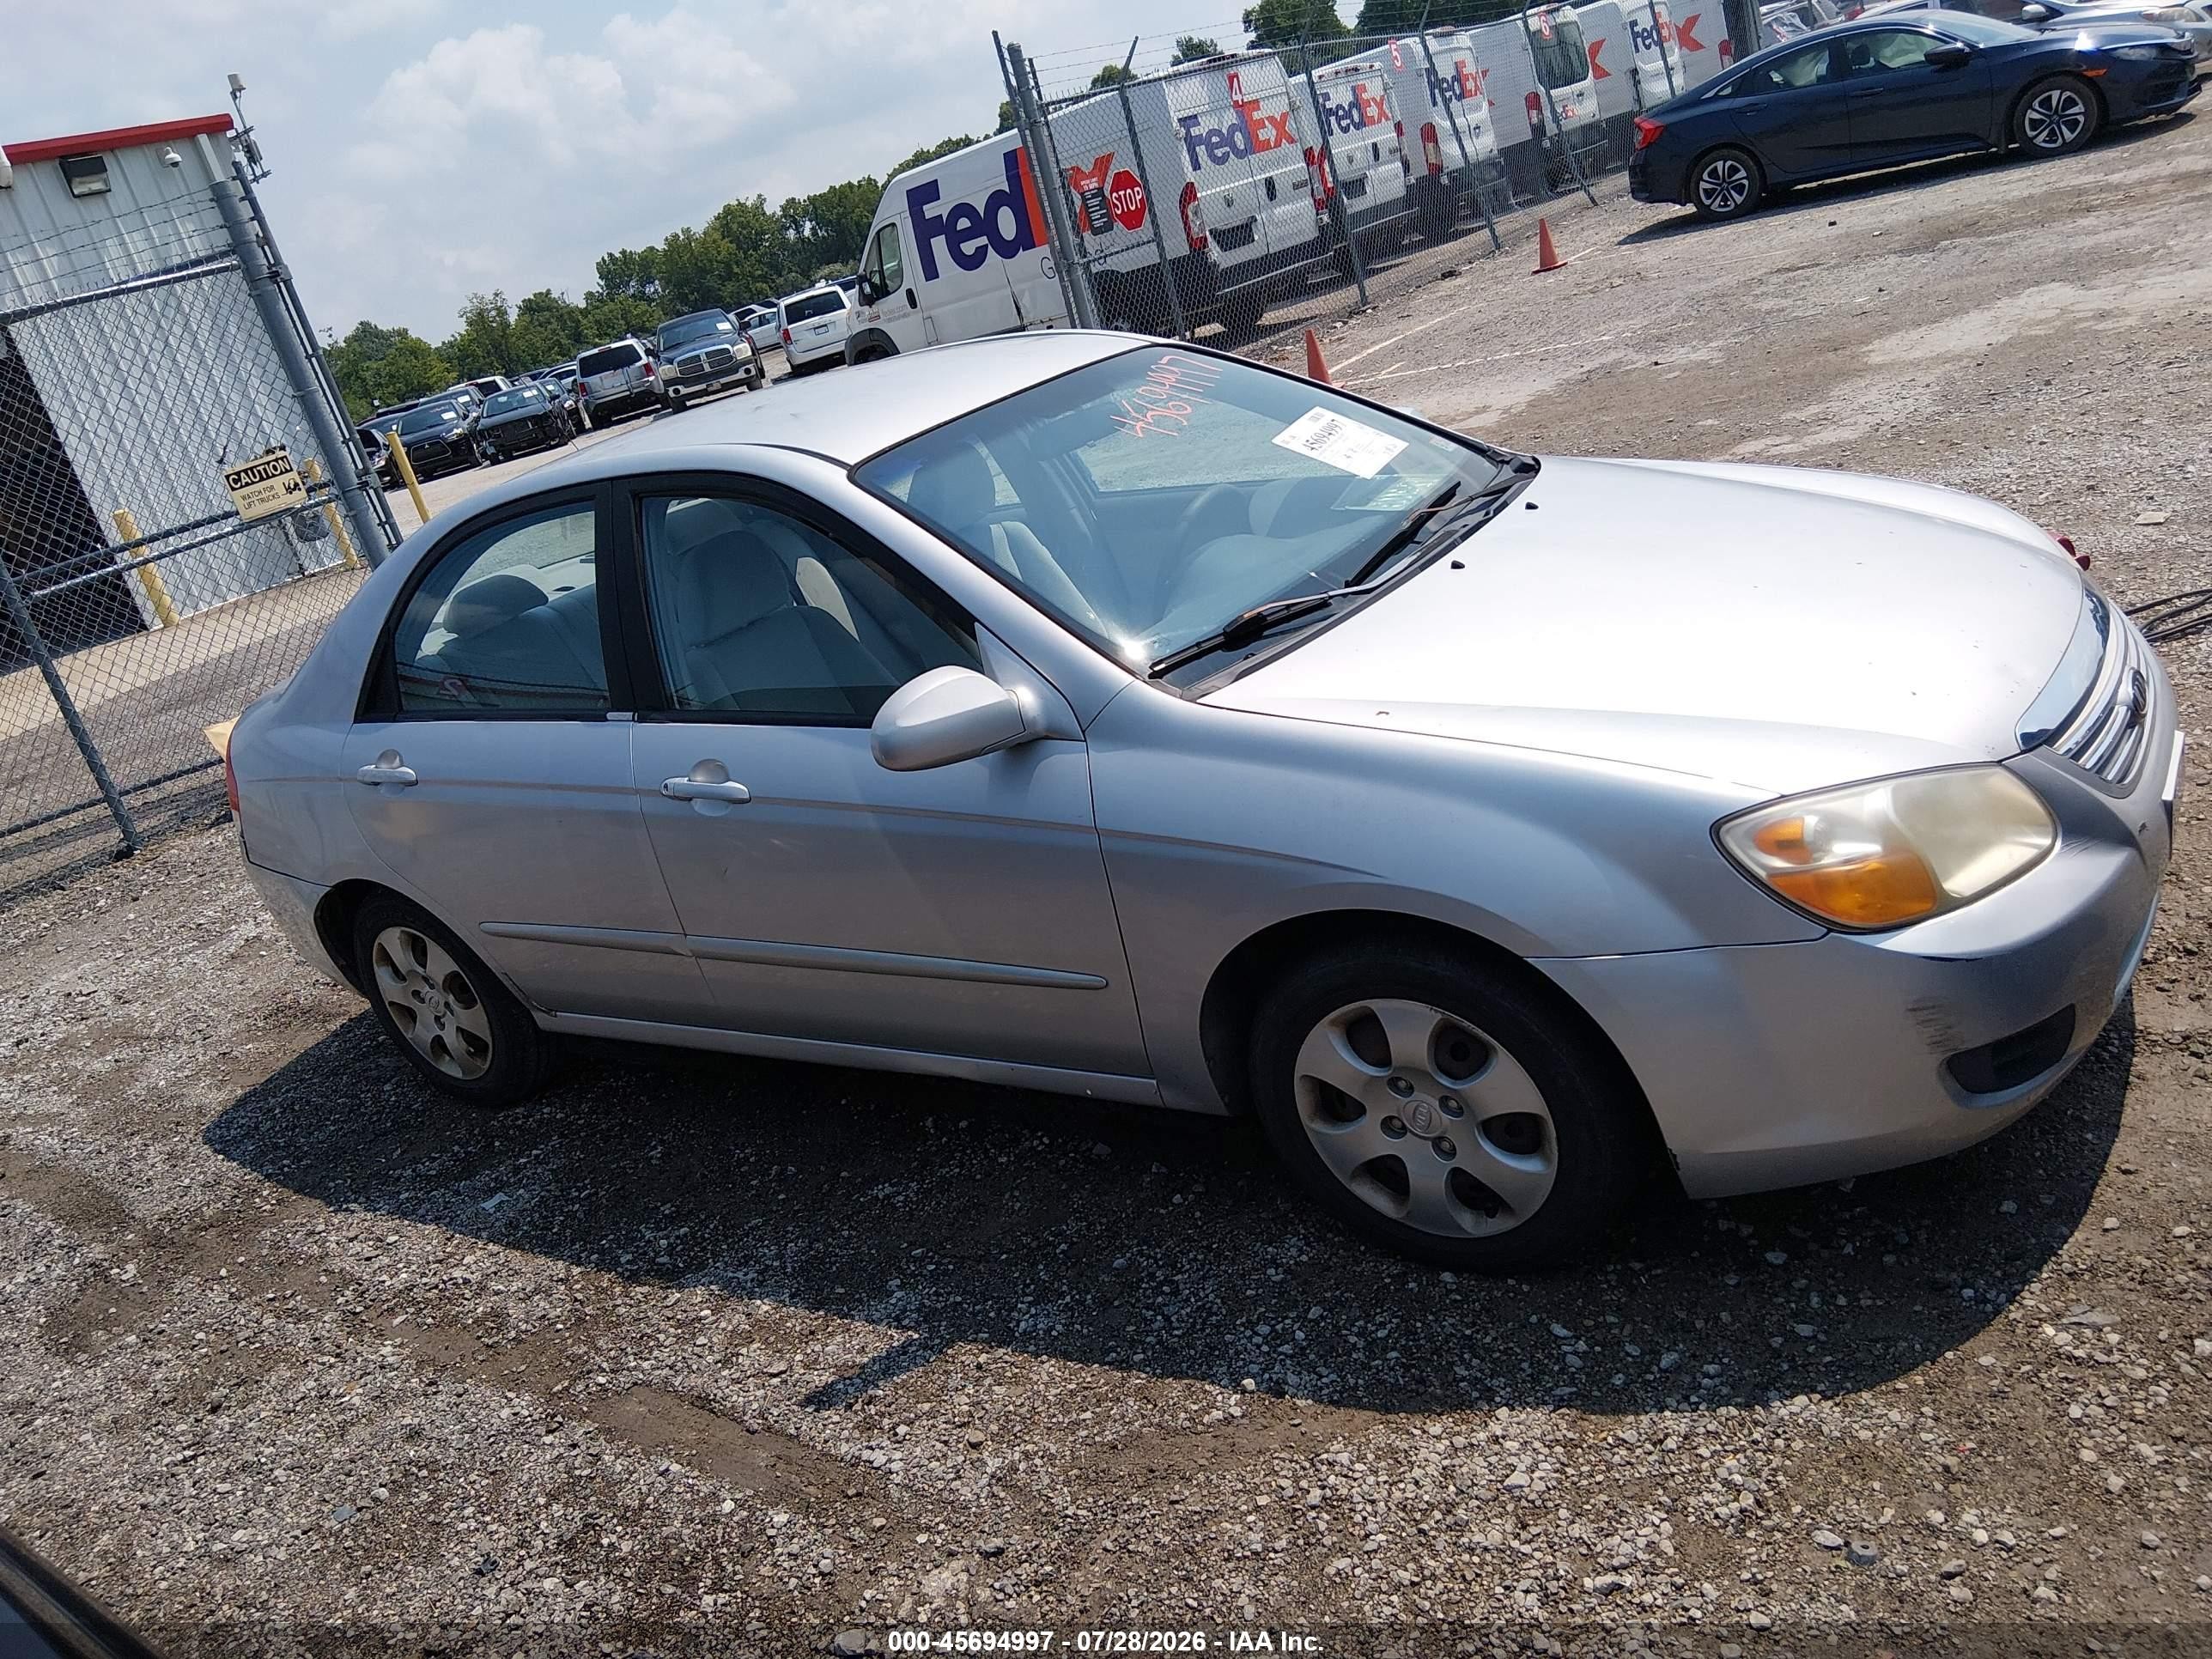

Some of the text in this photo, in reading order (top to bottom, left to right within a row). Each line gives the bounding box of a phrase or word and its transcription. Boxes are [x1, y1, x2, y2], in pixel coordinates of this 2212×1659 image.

[1540, 13, 1551, 36] 6
[1391, 42, 1401, 67] 5
[1231, 76, 1243, 106] 4
[1319, 82, 1393, 137] FedEx
[1177, 99, 1298, 173] FedEx
[1111, 186, 1143, 215] STOP
[1301, 418, 1347, 452] 45694997
[228, 457, 291, 489] CAUTION
[240, 484, 276, 501] WATCH FOR
[243, 500, 257, 510] LIFT
[257, 492, 281, 505] TRUCKS
